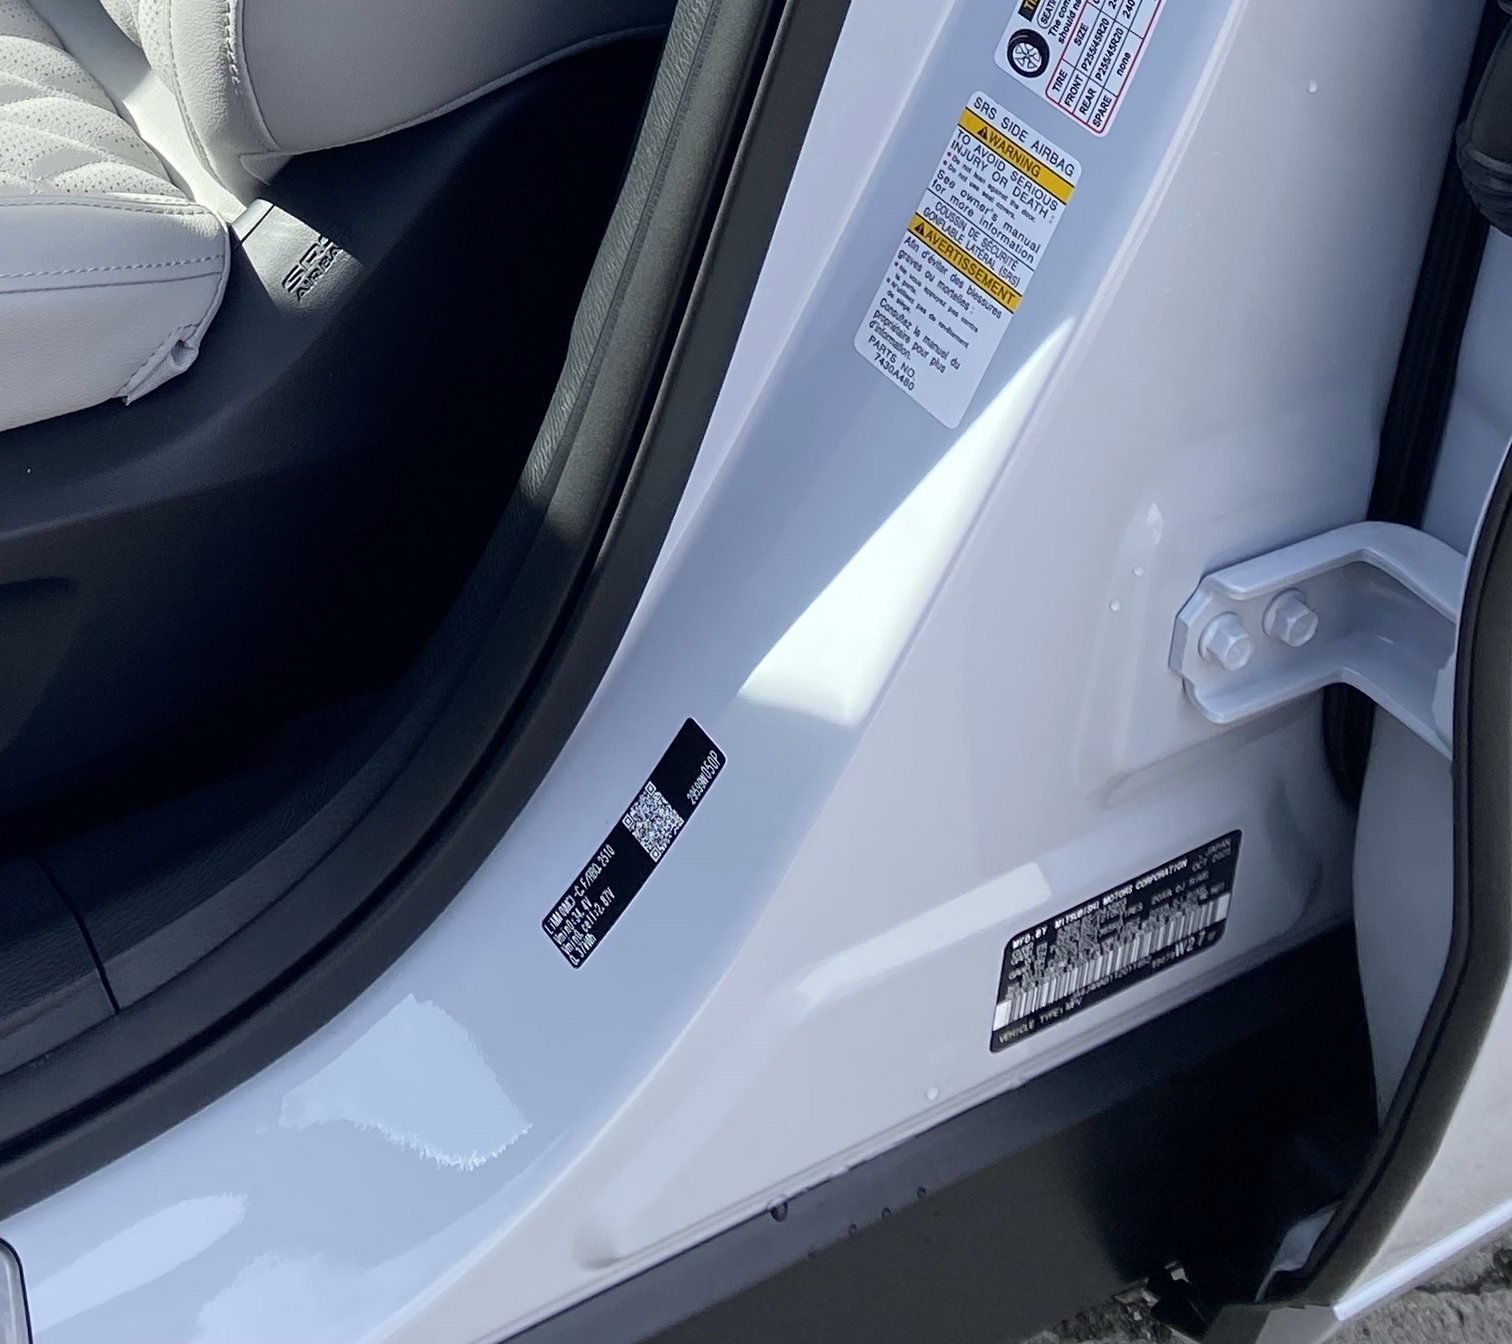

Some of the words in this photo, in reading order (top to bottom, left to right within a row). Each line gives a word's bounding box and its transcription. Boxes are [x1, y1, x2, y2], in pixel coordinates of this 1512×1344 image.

[1047, 17, 1061, 38] The
[1051, 68, 1068, 94] TIRE
[1072, 21, 1088, 47] SIZE
[1056, 9, 1076, 45] should
[1063, 72, 1084, 108] FRONT
[1080, 15, 1110, 72] P255/45R20
[1078, 86, 1096, 116] REAR
[1094, 25, 1124, 82] P255/45R20
[1091, 93, 1112, 128] SPARE
[1115, 50, 1131, 77] none
[949, 139, 988, 172] INJURY
[990, 169, 1009, 188] OR
[954, 128, 971, 146] TO
[972, 143, 1007, 173] AVOID
[1008, 170, 1059, 212] SERIOUS
[972, 95, 998, 121] SRS
[999, 115, 1029, 143] SIDE
[1029, 137, 1076, 177] AIRBAG
[986, 131, 1043, 178] WARNING
[921, 205, 965, 244] GONFLABLE
[997, 264, 1021, 289] (SRS)
[931, 178, 947, 195] for
[948, 193, 975, 218] more
[978, 215, 1036, 263] information
[933, 200, 968, 231] COUSSIN
[967, 226, 981, 242] DE
[980, 234, 1020, 271] SÉCURITÉ
[935, 168, 957, 190] See
[959, 187, 1000, 222] owner's
[1001, 219, 1041, 254] manual
[897, 248, 923, 274] graves
[923, 269, 935, 283] ou
[903, 234, 920, 253] Afin
[949, 271, 965, 289] des
[965, 284, 1003, 319] blessures
[923, 228, 1016, 306] AVERTISSEMENT
[868, 334, 897, 363] PARTS
[878, 296, 913, 330] Consultez
[912, 325, 922, 338] le
[922, 333, 949, 360] manuel
[949, 355, 961, 370] du
[911, 341, 929, 360] pour
[929, 354, 947, 375] plus
[873, 352, 915, 391] 7430A480
[1053, 899, 1100, 930] MITSUBISHI
[1102, 883, 1133, 906] MOTORS
[1134, 857, 1187, 891] CORPORATION
